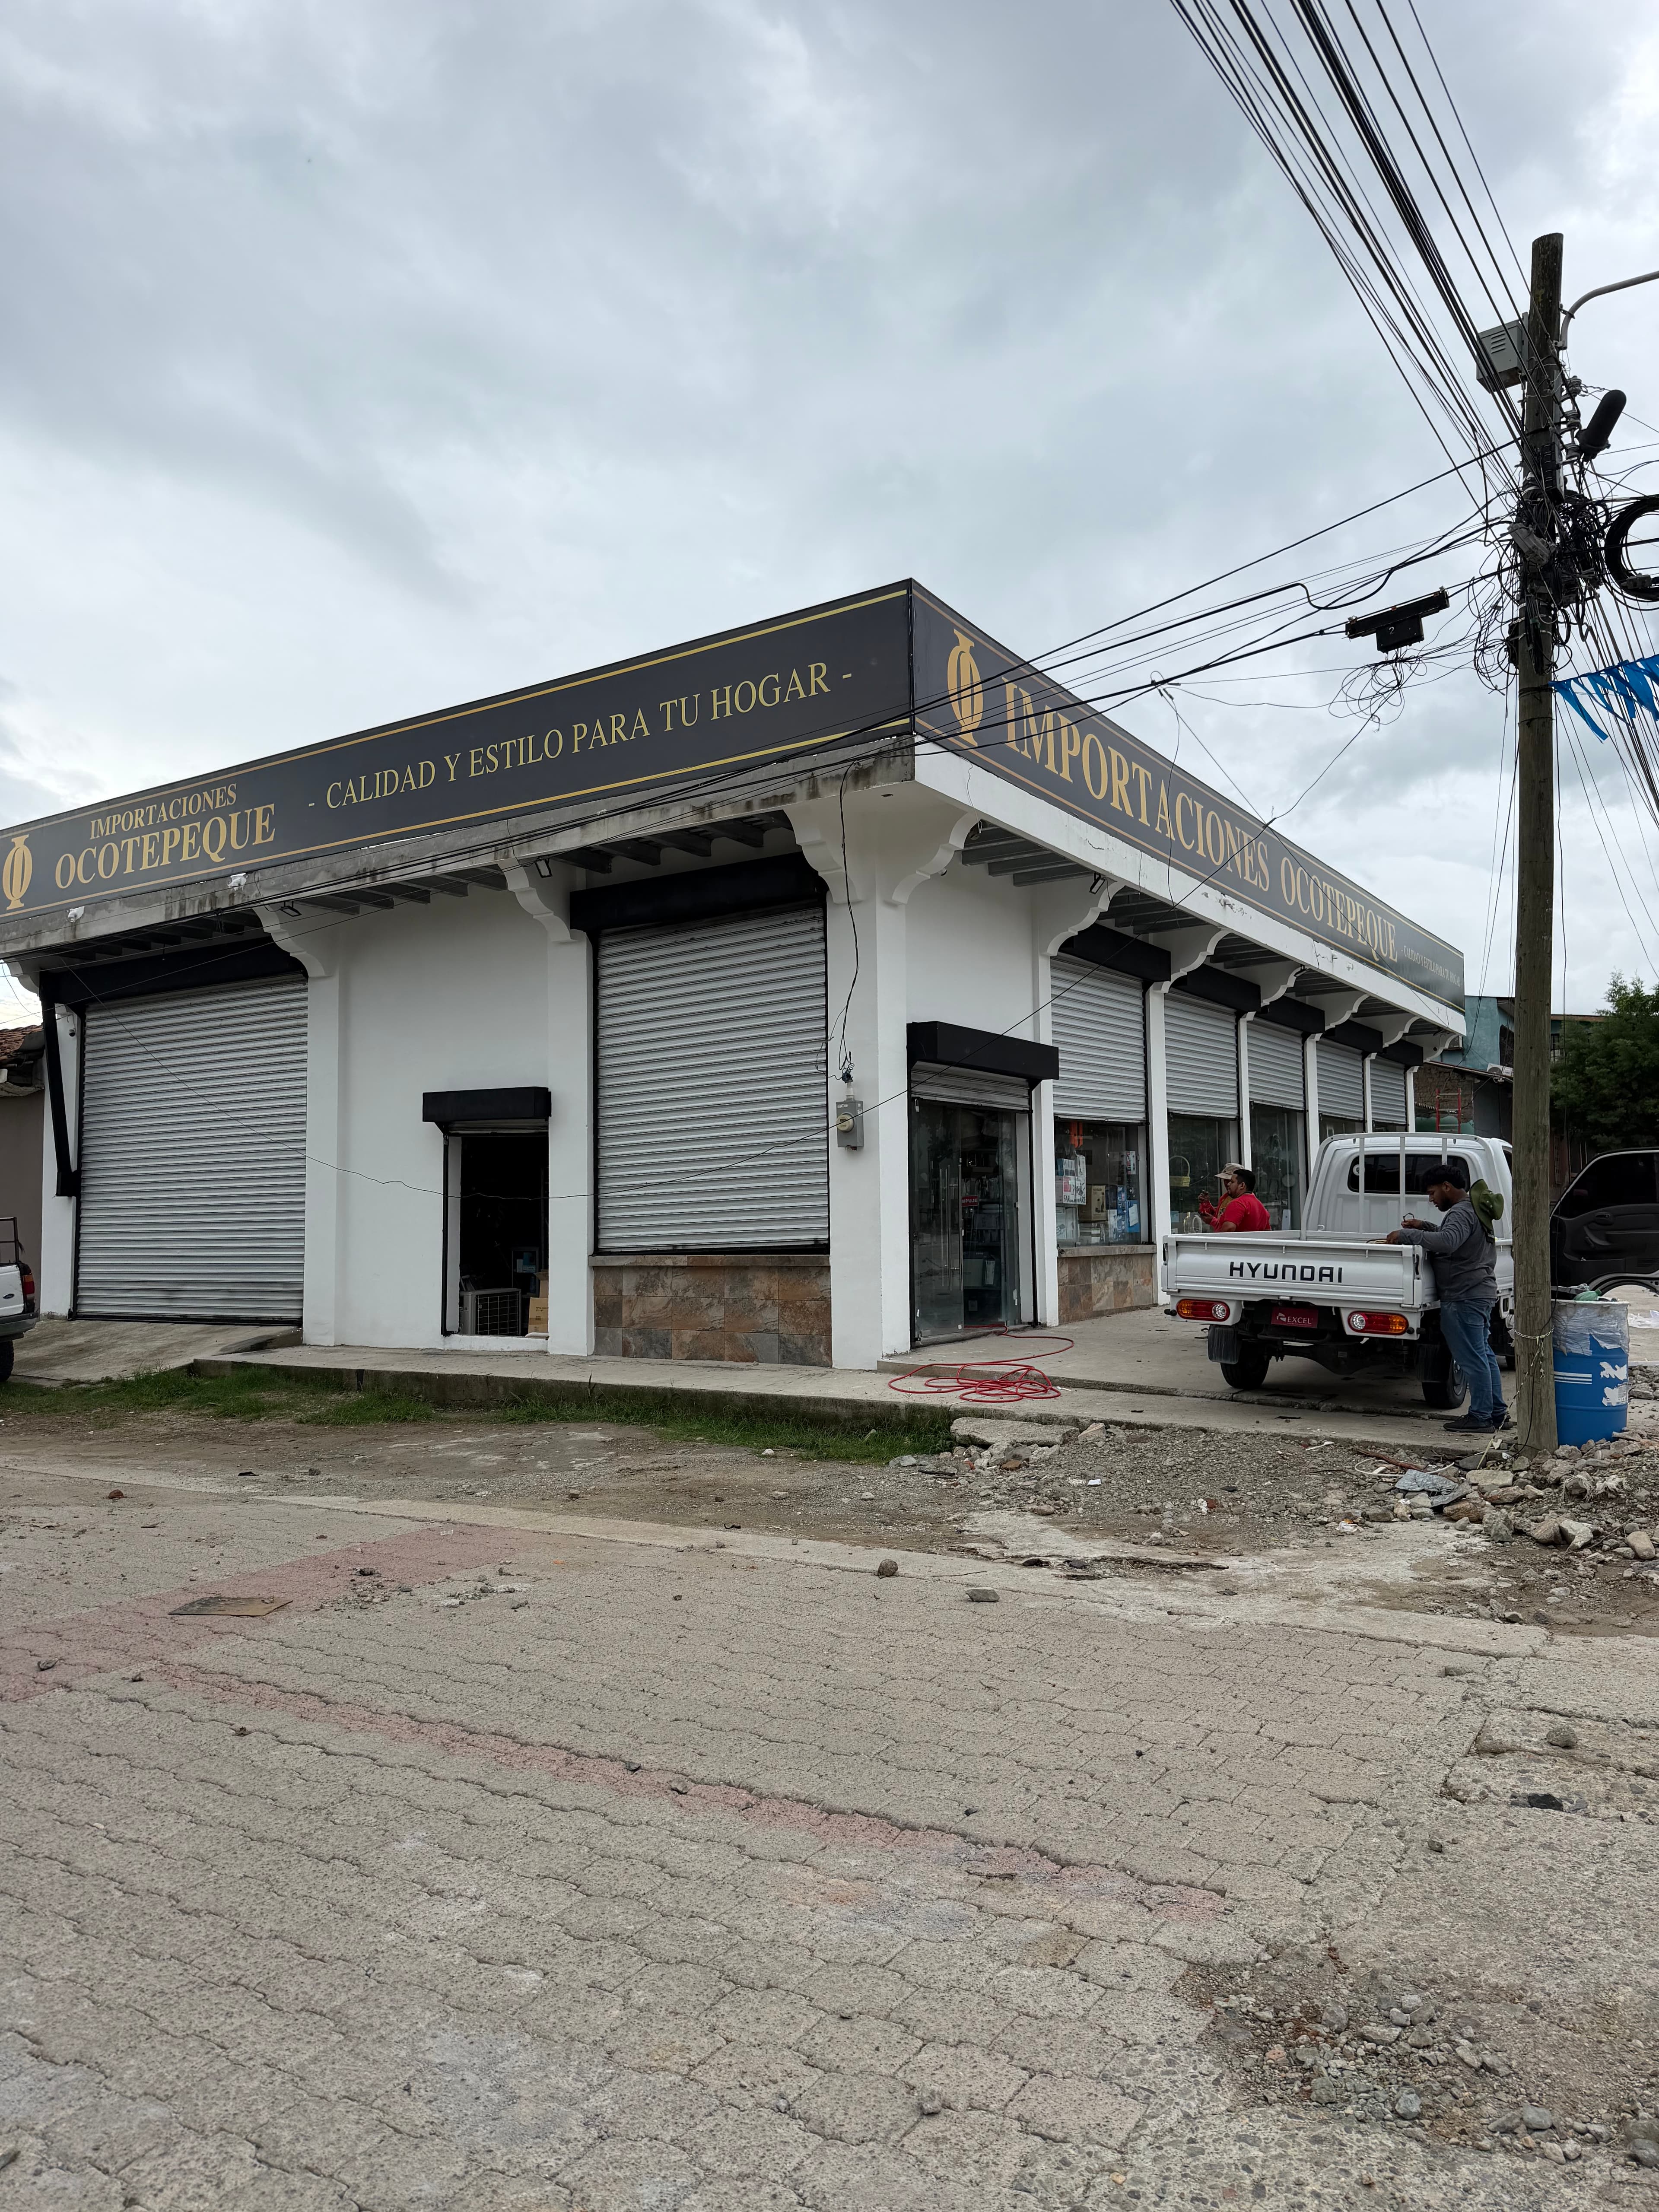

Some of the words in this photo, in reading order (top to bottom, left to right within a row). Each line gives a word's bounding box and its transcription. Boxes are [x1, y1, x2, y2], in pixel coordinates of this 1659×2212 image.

[326, 760, 435, 809] CALIDAD
[444, 753, 461, 782] Y
[468, 728, 563, 777] ESTILO
[572, 708, 650, 753] PARA
[659, 693, 701, 732] TU
[710, 662, 831, 721] HOGAR
[55, 803, 275, 889] OCOTEPEQUE
[90, 783, 237, 840] IMPORTACIONES
[1001, 676, 1270, 893] IMPORTACIONES
[1280, 857, 1398, 963] OCOTEPEQUE
[1404, 945, 1421, 964] CALIDAD
[1229, 1261, 1343, 1283] HYUNDAI
